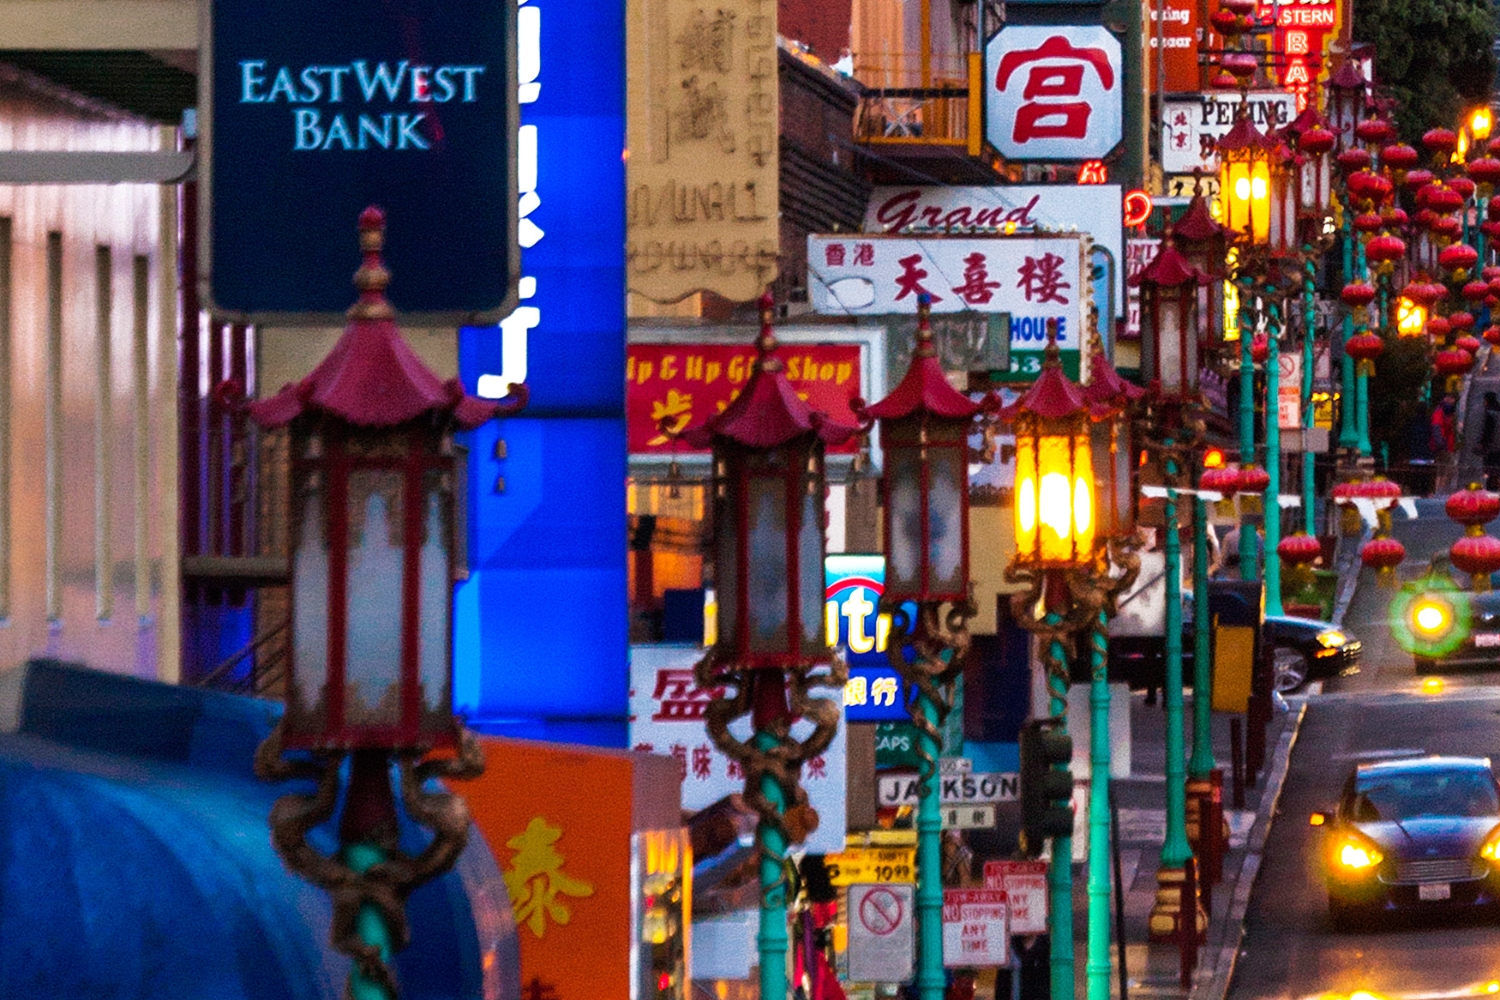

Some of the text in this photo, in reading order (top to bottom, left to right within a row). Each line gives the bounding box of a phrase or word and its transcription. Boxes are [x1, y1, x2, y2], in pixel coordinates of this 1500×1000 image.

[292, 106, 431, 151] BANK
[876, 190, 1040, 232] Grand
[894, 251, 1071, 305] 天喜樓
[1010, 317, 1067, 341] HOUE
[786, 356, 851, 384] Shop
[876, 736, 911, 752] APS
[886, 778, 1018, 800] JAKSON
[962, 924, 988, 937] ANY
